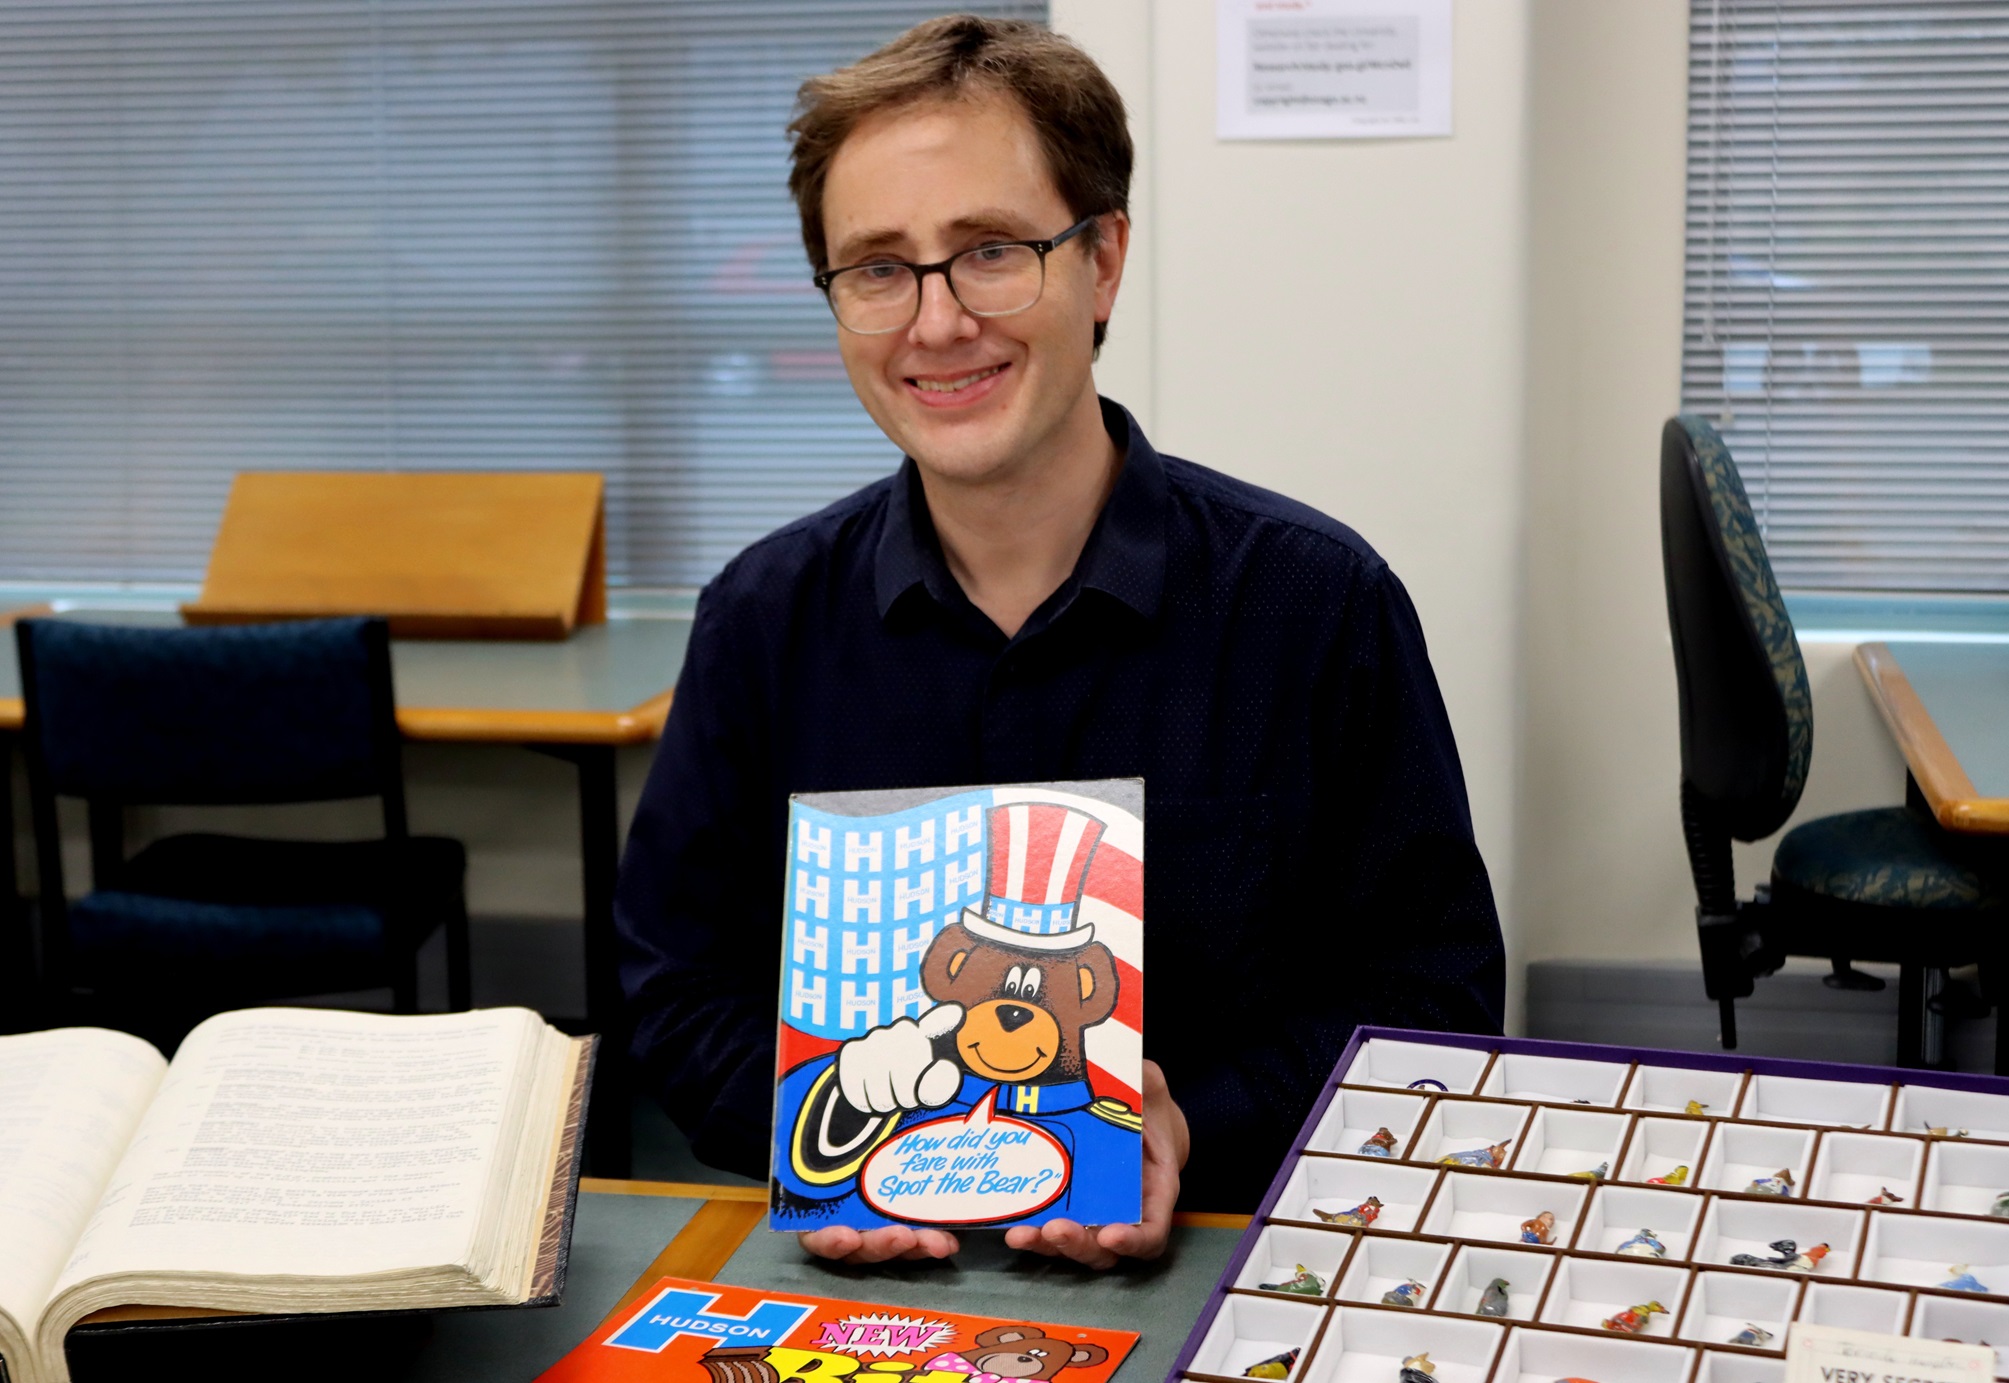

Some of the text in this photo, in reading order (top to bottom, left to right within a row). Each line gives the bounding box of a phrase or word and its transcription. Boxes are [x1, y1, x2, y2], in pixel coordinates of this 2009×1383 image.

[950, 821, 979, 835] HUDSON
[900, 837, 931, 849] HUDSON
[949, 868, 979, 885] HUDSON
[847, 896, 877, 904] HUDSON
[899, 887, 930, 900] HUDSON
[797, 937, 825, 949] HUDSON
[897, 939, 930, 952] HUDSON
[846, 948, 877, 956] HUDSON
[795, 990, 823, 1000] HUDSON
[846, 999, 876, 1007] HUDSON
[1016, 1086, 1040, 1113] H
[947, 1128, 990, 1150] did
[984, 1130, 1033, 1151] you
[900, 1151, 999, 1175] fare with
[877, 1175, 934, 1203] Spot
[934, 1172, 976, 1195] the
[649, 1314, 772, 1338] HUDSON
[811, 1322, 945, 1348] NEW
